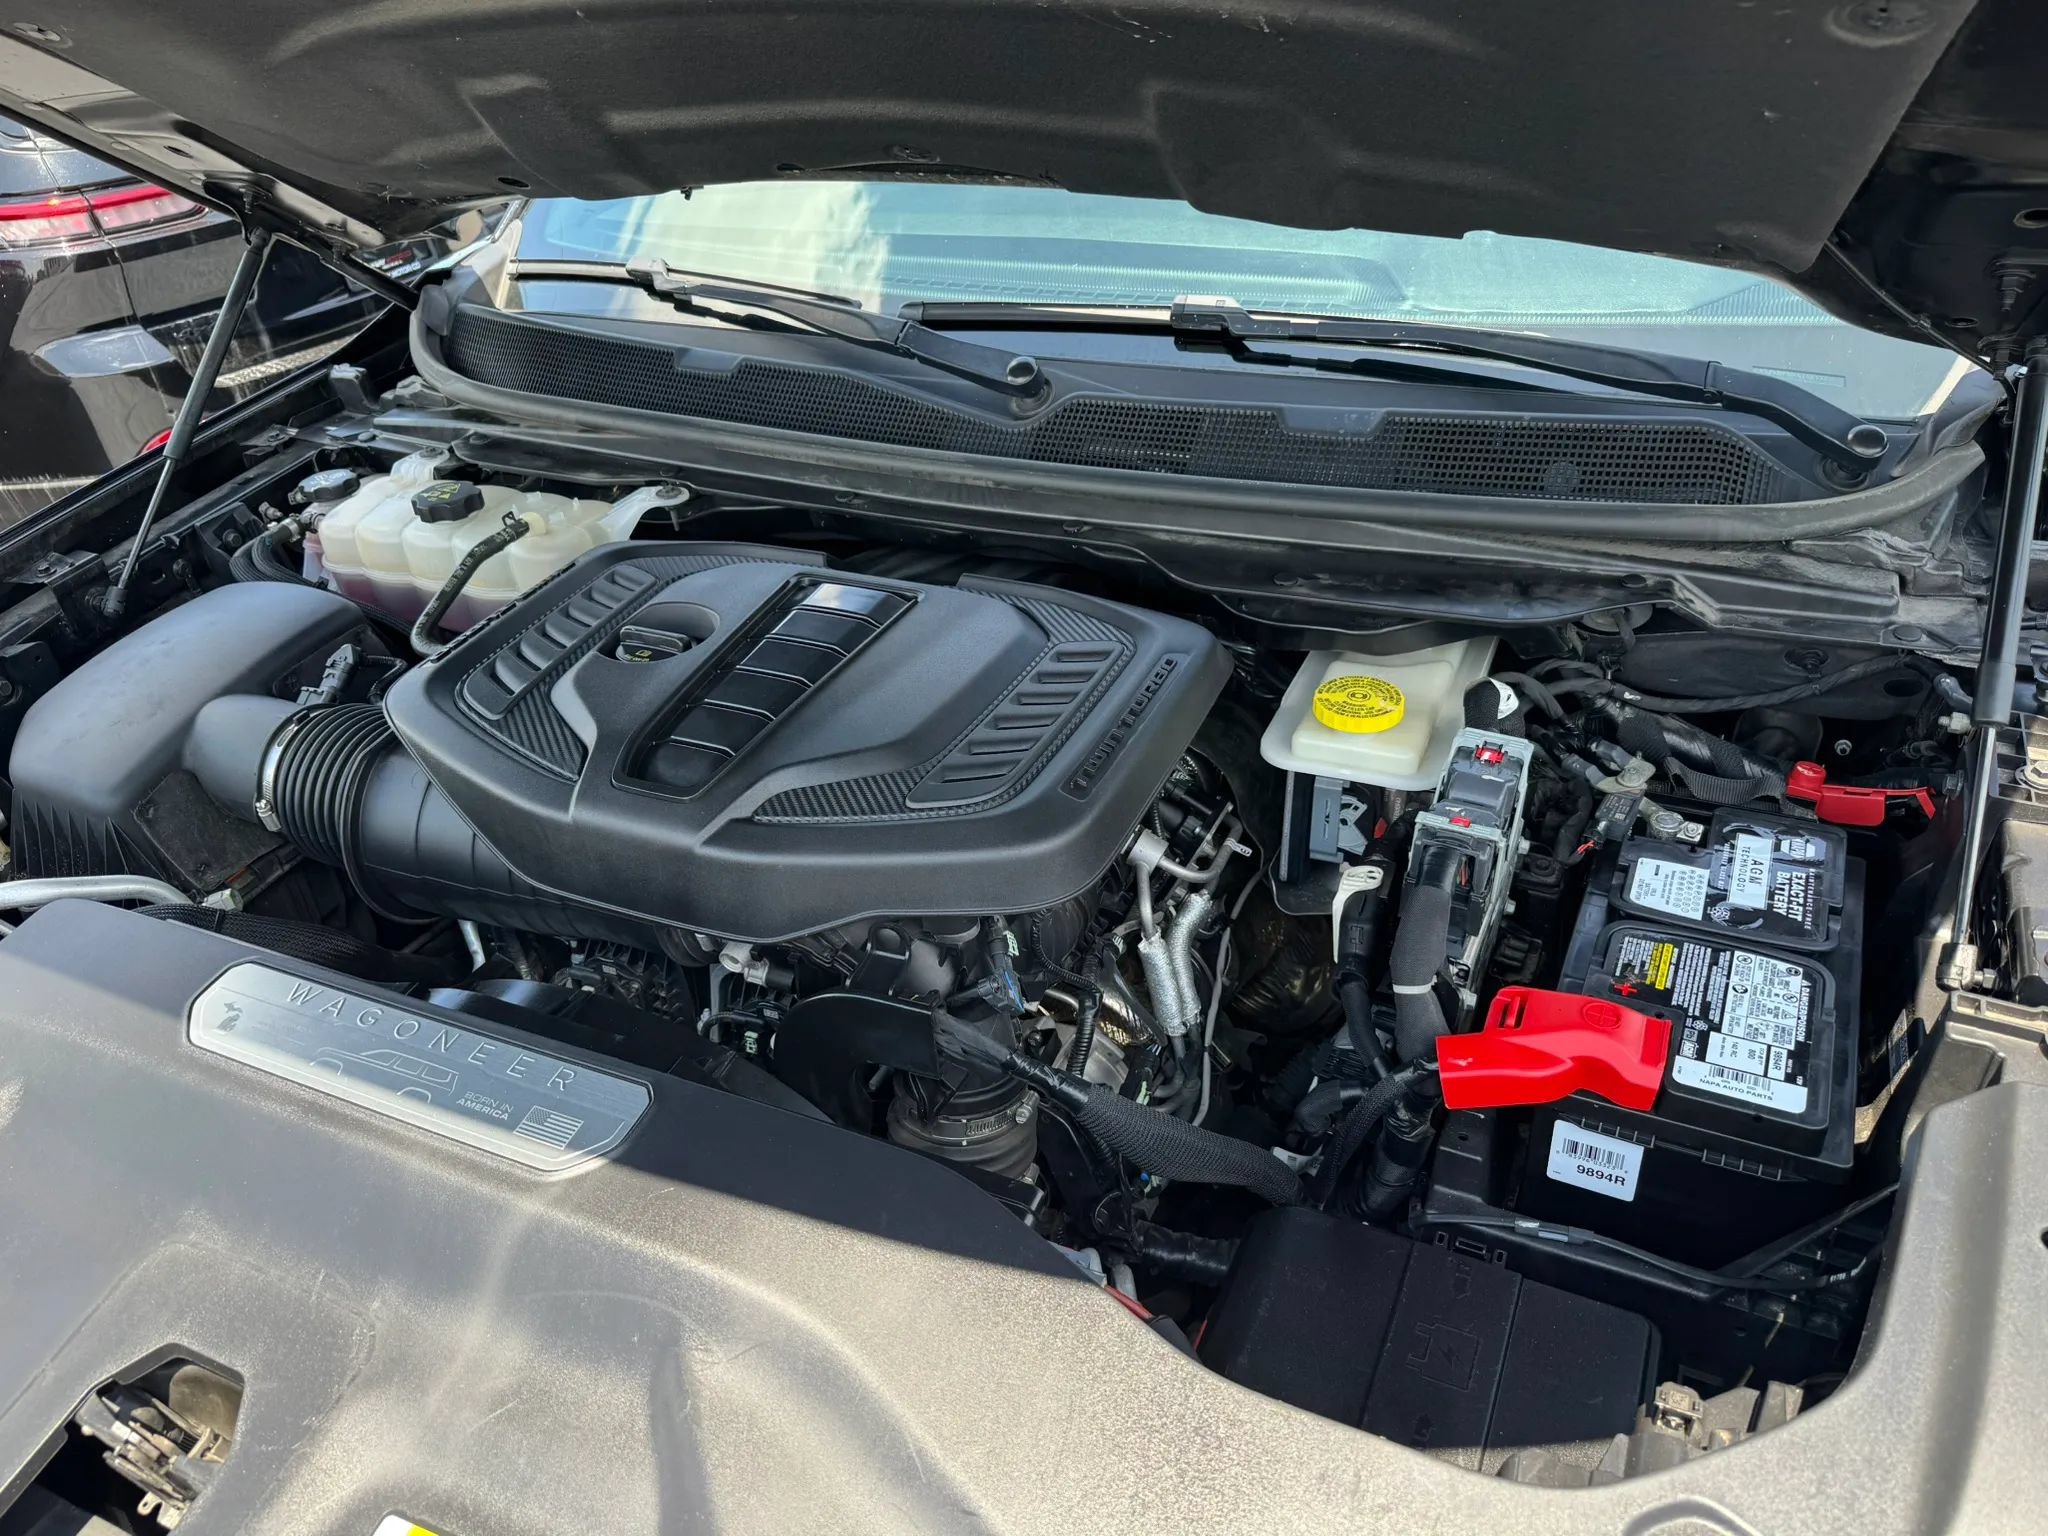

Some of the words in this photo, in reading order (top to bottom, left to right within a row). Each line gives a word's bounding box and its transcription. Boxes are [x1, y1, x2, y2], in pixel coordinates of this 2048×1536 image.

[1070, 727, 1125, 789] TWIN
[1119, 658, 1177, 728] TURBO
[1736, 846, 1751, 894] TECHNOLOGY
[1748, 858, 1764, 885] AGM
[1773, 871, 1790, 916] BATTERY
[1804, 868, 1816, 930] MAINTENANCE-FREE
[1796, 987, 1810, 1042] DANGER/POISON
[287, 981, 578, 1092] WAGONEER
[1772, 1050, 1783, 1071] 9894R
[464, 1091, 499, 1107] BORN
[500, 1103, 514, 1113] IN
[1699, 1077, 1722, 1087] NAPA
[1722, 1084, 1745, 1094] AUTO
[1746, 1090, 1773, 1101] PARTS
[456, 1098, 509, 1120] AMERICA
[1576, 1164, 1626, 1187] 9894R
